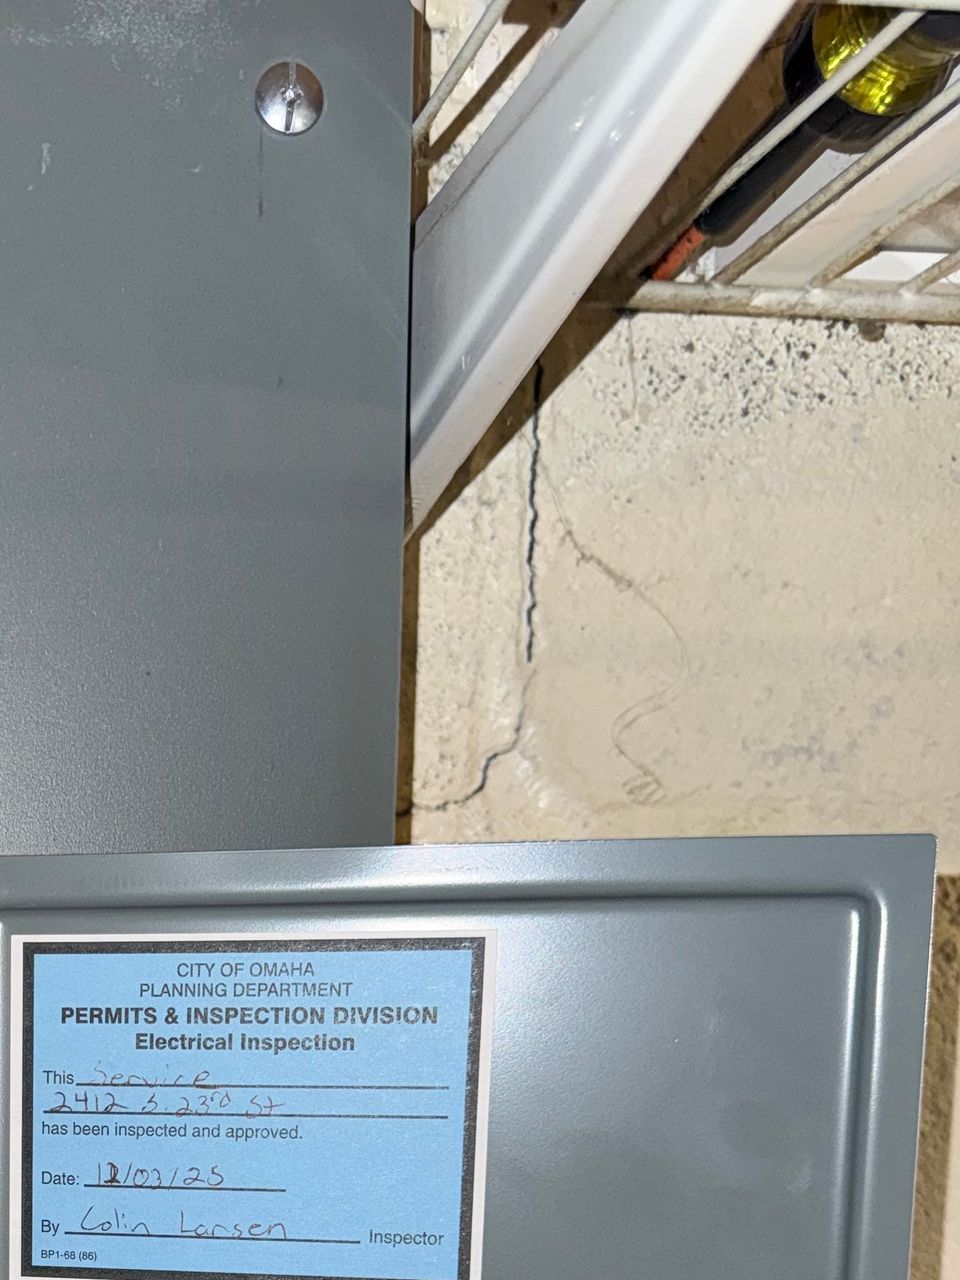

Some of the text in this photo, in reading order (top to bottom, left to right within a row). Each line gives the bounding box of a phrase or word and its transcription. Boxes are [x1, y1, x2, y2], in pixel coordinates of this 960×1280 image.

[177, 963, 315, 977] CITY OF OMAHA
[139, 983, 353, 998] PLANNING DEPARTMENT
[61, 1007, 438, 1025] PERMITS & INSPECTION DIVISION
[135, 1033, 355, 1054] Electrical Inspection
[43, 1071, 74, 1085] This
[50, 1092, 129, 1112] 2412
[42, 1122, 303, 1141] has been inspected and approved.
[41, 1172, 80, 1185] Date:
[41, 1220, 60, 1235] By
[369, 1231, 444, 1247] Inspector
[41, 1250, 97, 1262] BP1-68 (86)
